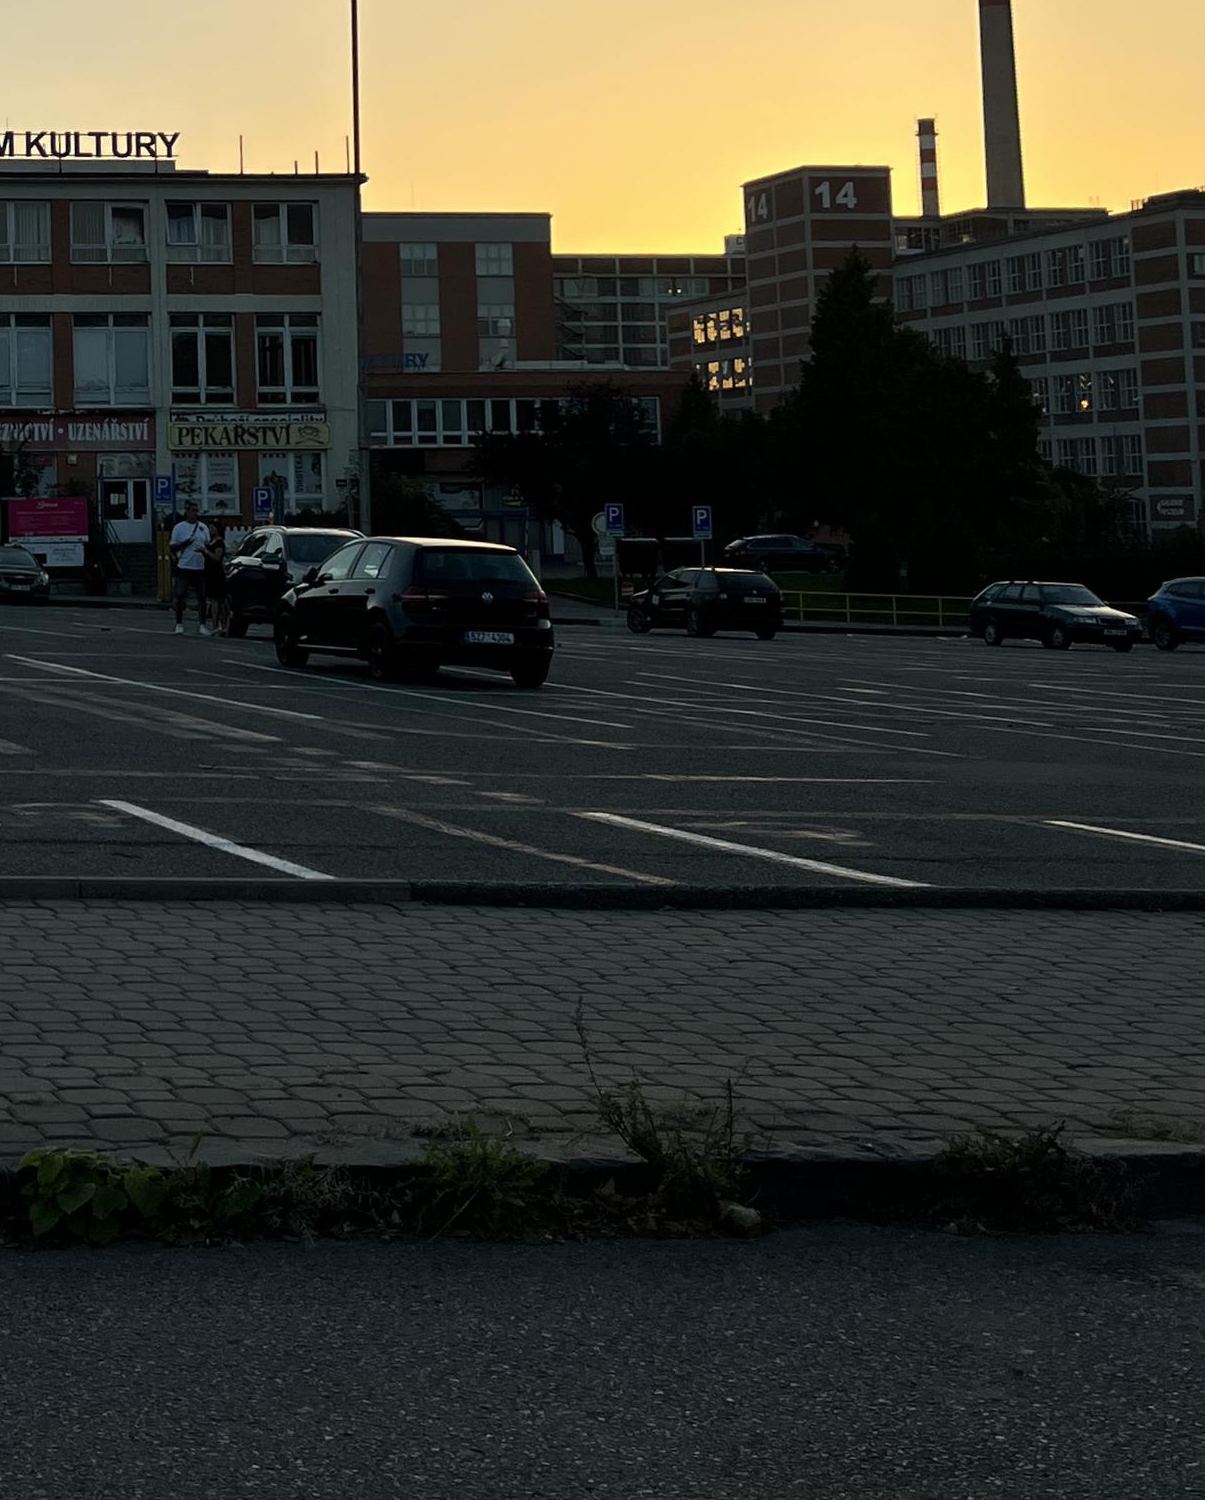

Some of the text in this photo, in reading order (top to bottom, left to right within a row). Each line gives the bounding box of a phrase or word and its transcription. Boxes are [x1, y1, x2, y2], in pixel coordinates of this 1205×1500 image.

[25, 131, 181, 158] KULTURY
[814, 181, 858, 209] 14
[748, 193, 768, 222] 14
[67, 417, 150, 441] UZENÁŘSTVÍ
[177, 424, 291, 446] PEKAŘSTVÍ
[157, 478, 169, 495] P
[257, 490, 269, 506] P
[608, 507, 620, 523] P
[696, 509, 708, 525] P
